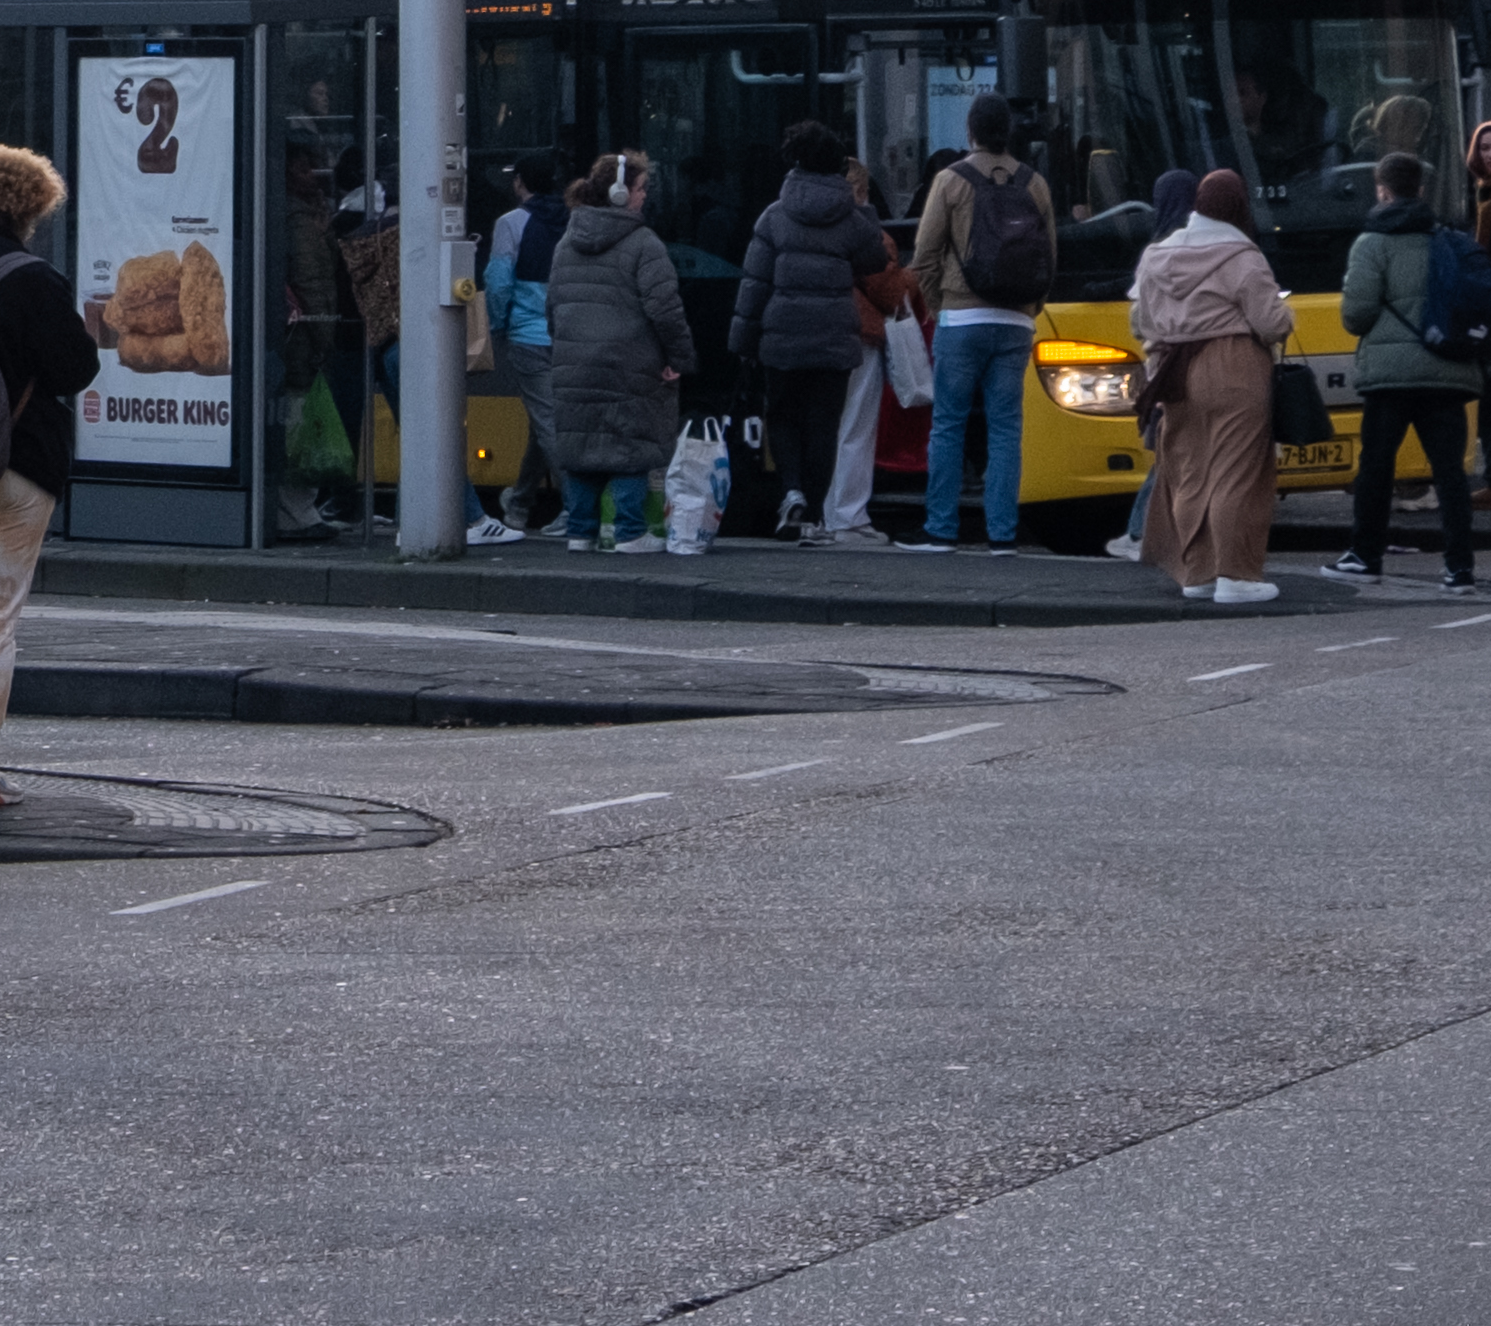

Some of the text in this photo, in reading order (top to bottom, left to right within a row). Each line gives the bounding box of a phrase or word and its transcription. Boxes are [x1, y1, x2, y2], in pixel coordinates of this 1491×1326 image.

[107, 396, 229, 427] BURGER KING
[1277, 445, 1343, 467] 7-BJN-2
